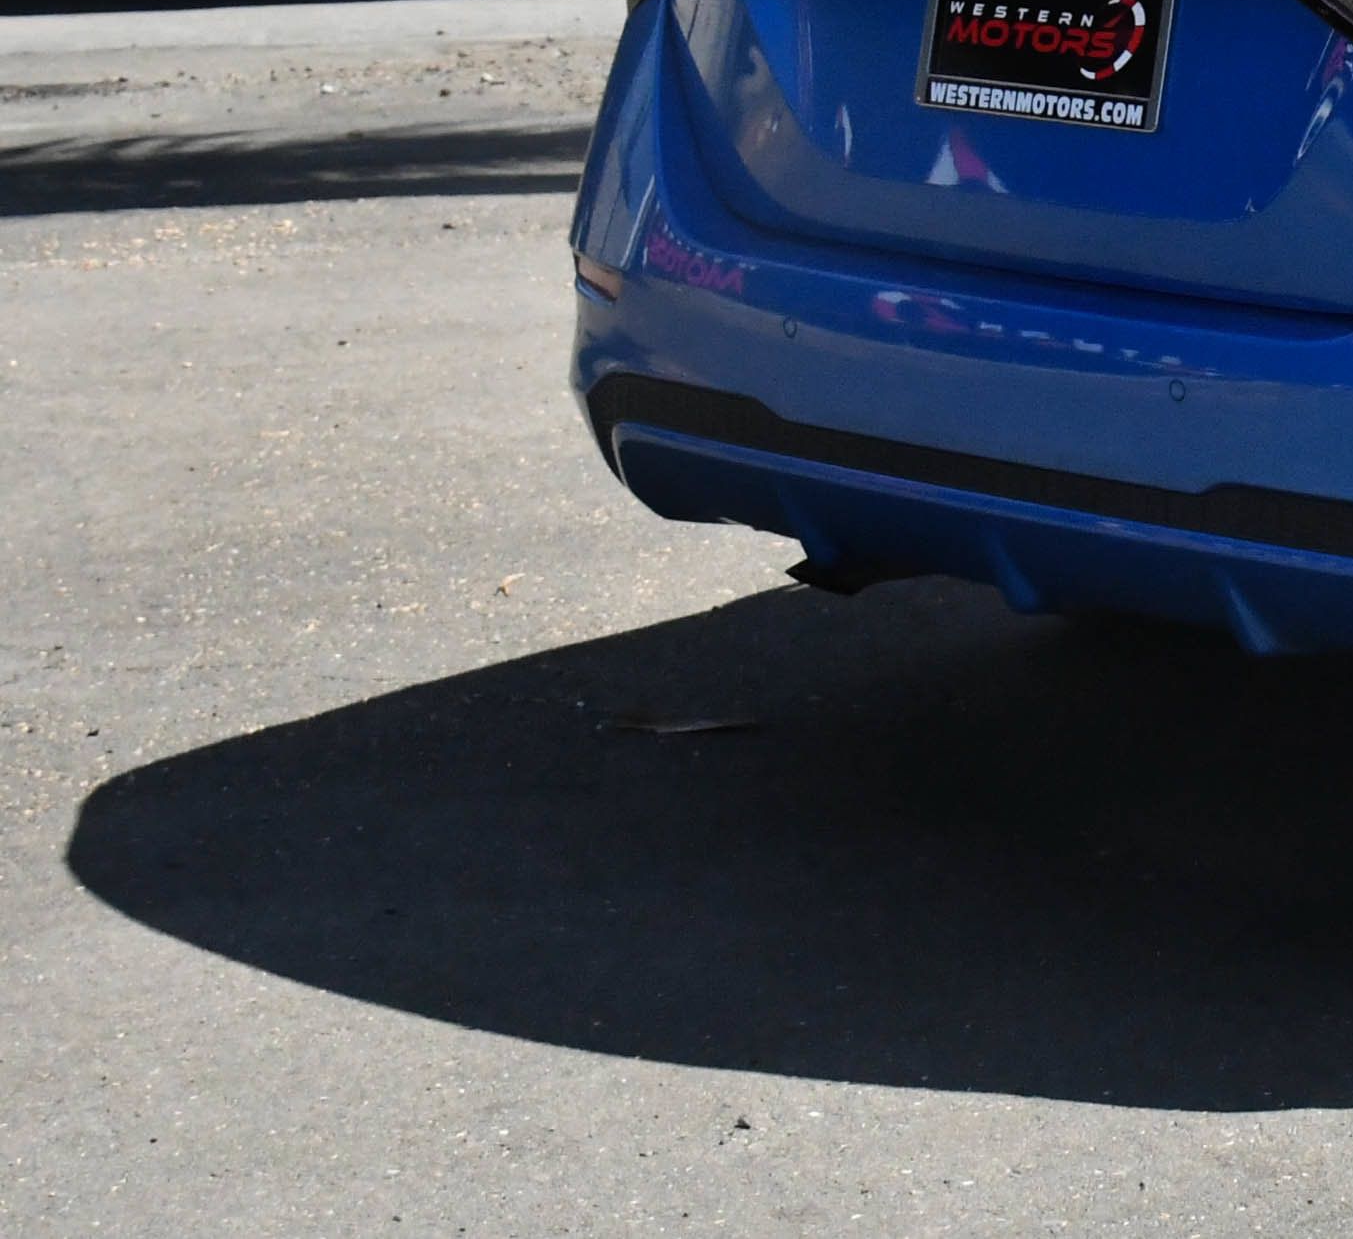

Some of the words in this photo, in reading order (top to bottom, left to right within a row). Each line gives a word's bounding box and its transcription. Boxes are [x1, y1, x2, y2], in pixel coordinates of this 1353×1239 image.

[950, 0, 1095, 28] WESTERN
[947, 17, 1117, 59] MOTORS
[930, 81, 1144, 127] WESTERNMOTORS.COM
